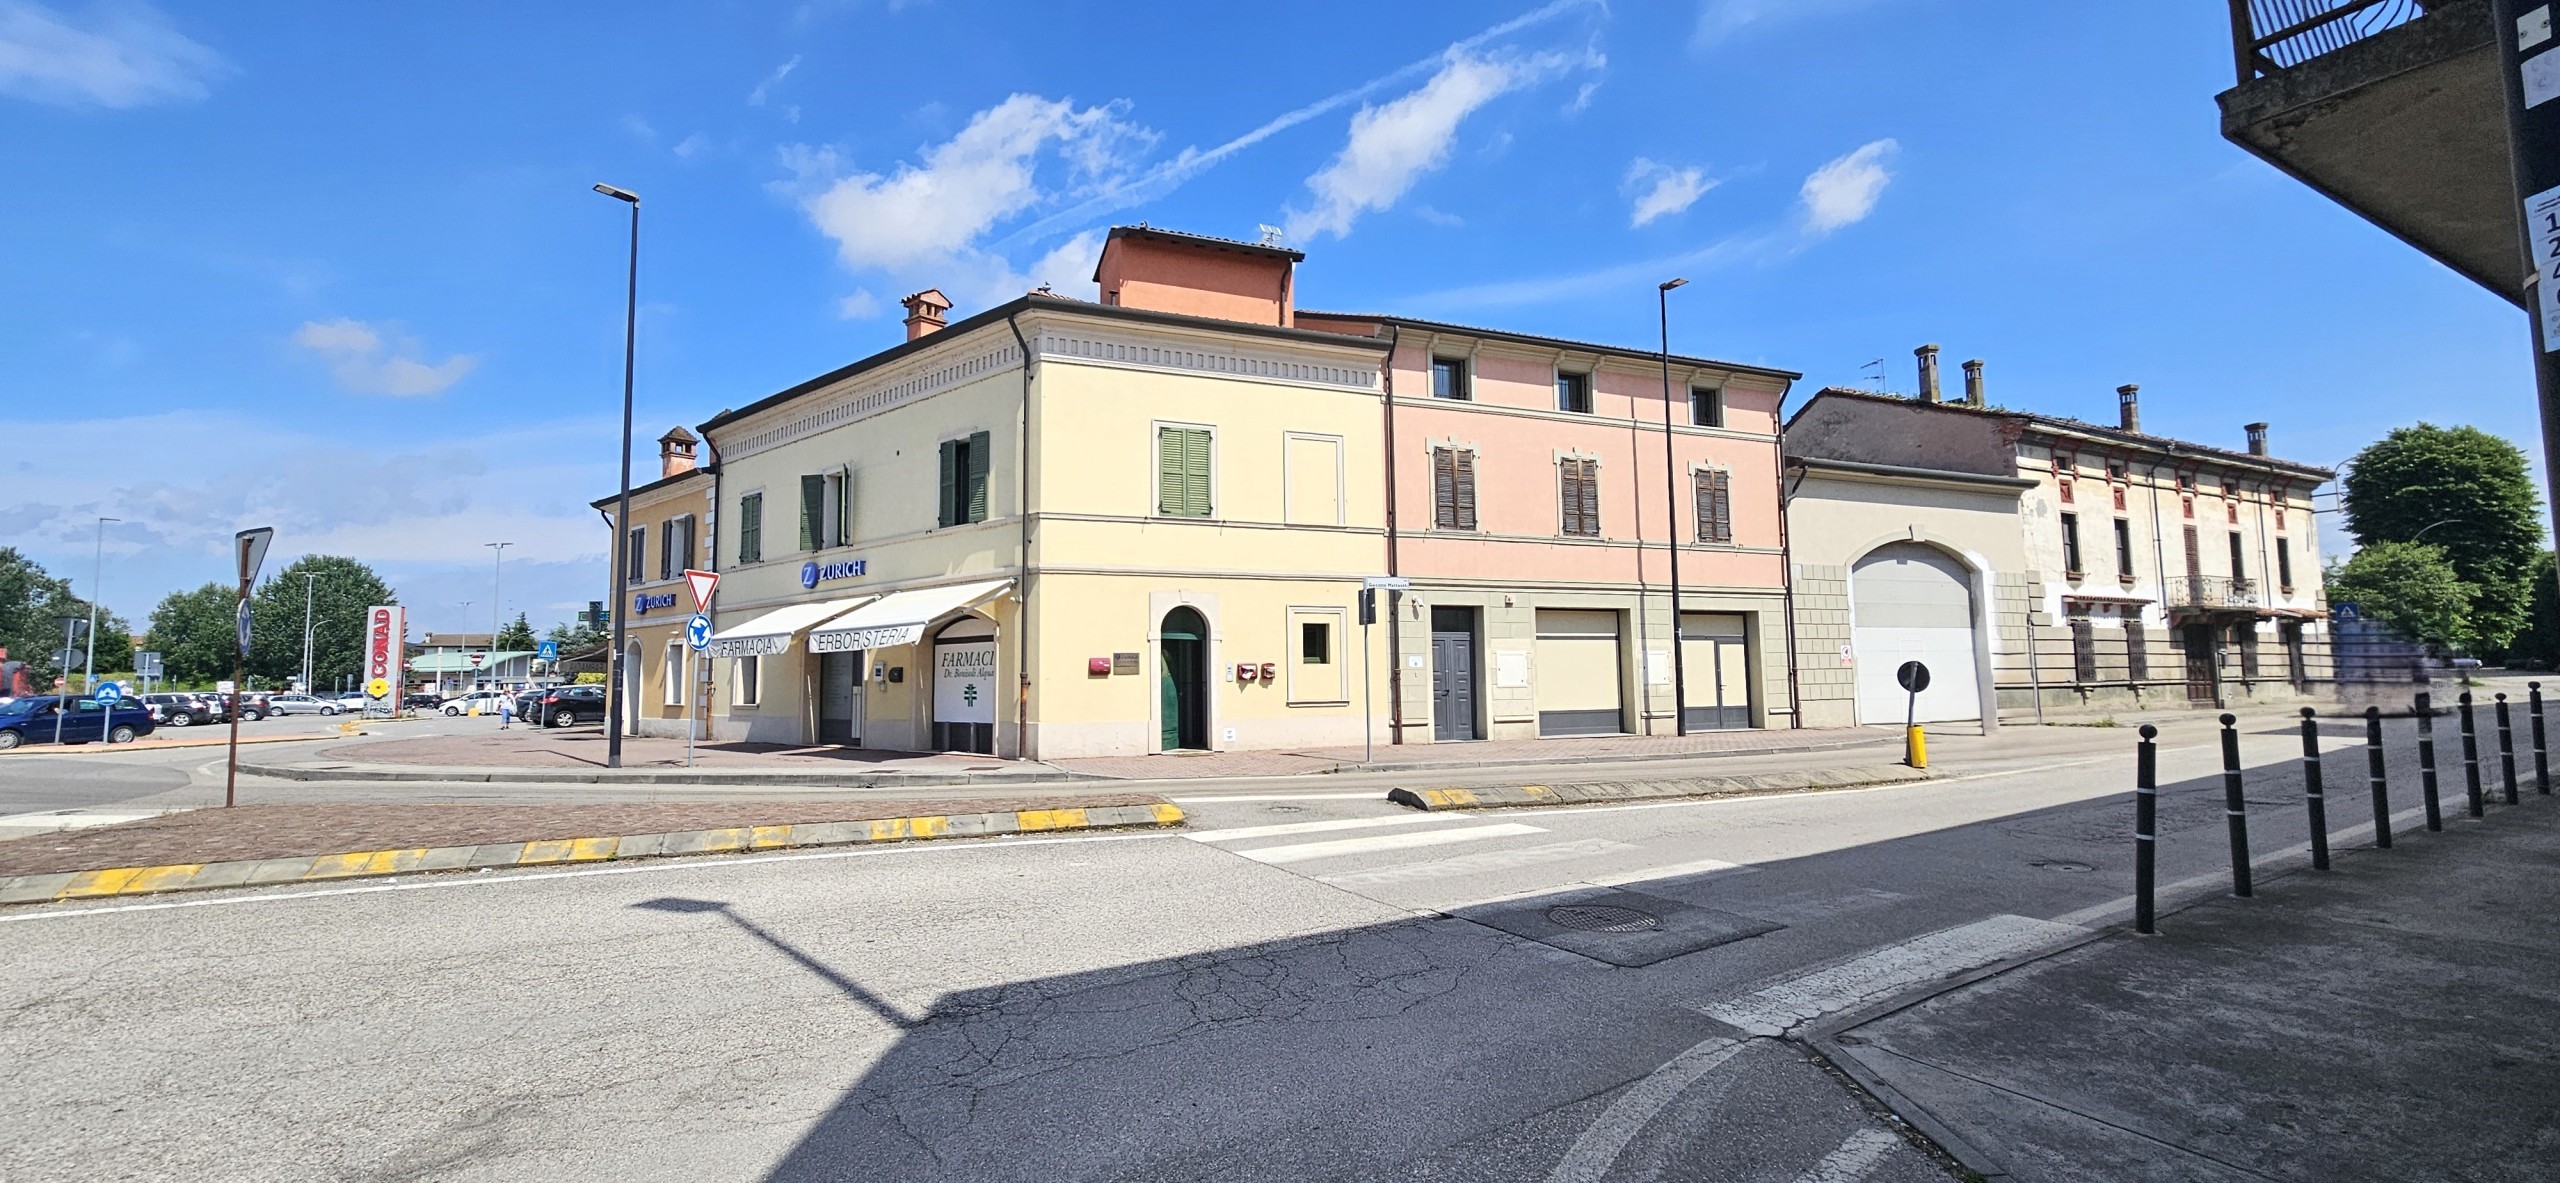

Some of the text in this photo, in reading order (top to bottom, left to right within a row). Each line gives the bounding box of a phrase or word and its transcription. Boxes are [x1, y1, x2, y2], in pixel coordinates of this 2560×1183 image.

[819, 560, 862, 581] ZURICH
[646, 594, 672, 609] ZURICH
[371, 608, 391, 679] CONAD
[721, 638, 772, 657] FARMACIA
[818, 627, 910, 651] ERBORISTERIA
[941, 650, 995, 667] FARMACI
